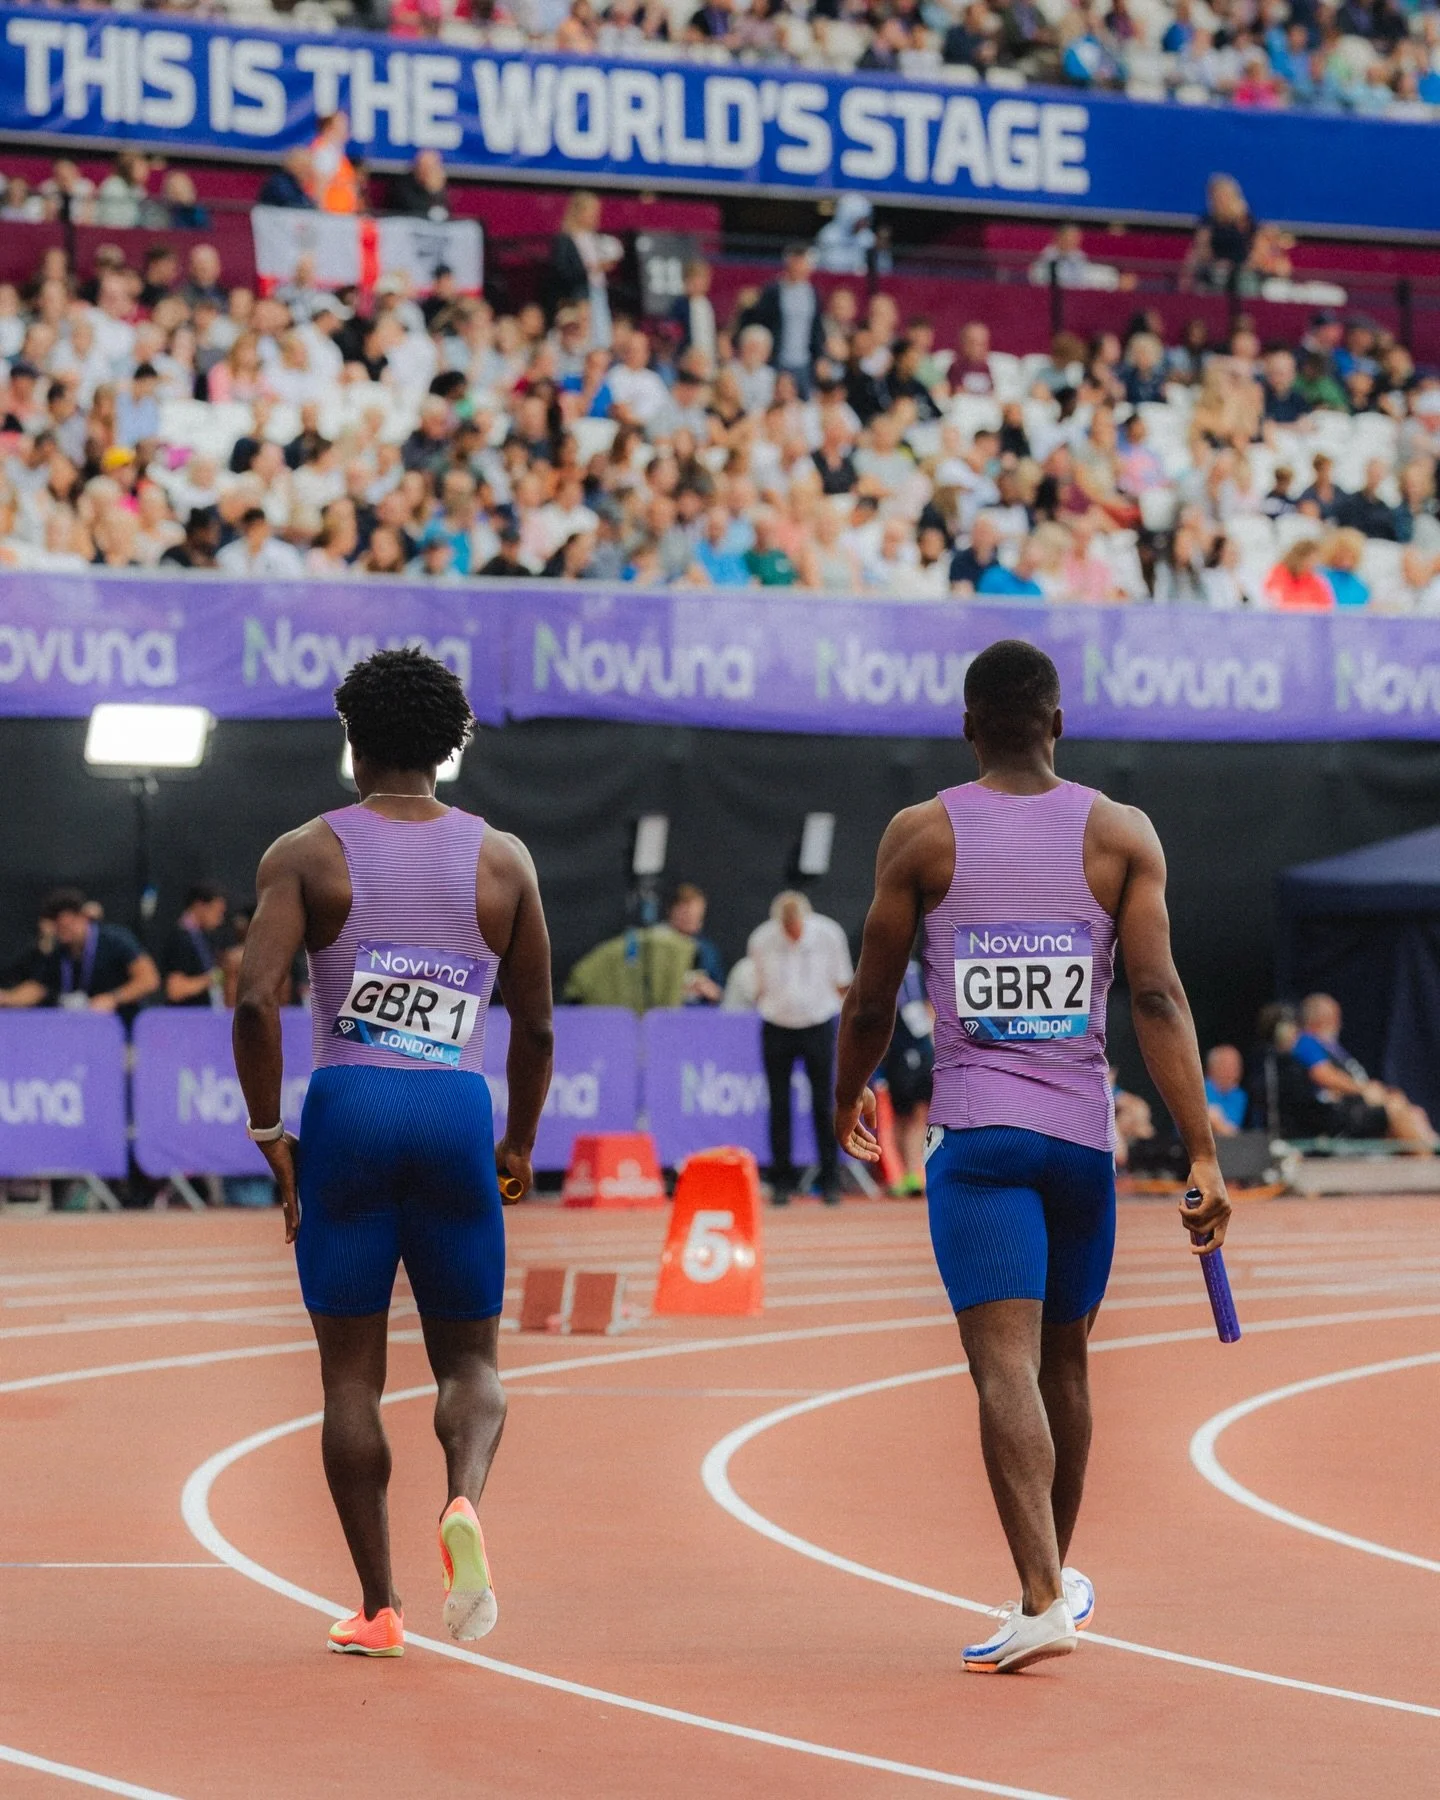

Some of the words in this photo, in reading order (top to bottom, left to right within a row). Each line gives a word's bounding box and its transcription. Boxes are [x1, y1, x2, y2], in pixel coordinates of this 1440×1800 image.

[6, 17, 197, 130] THIS
[208, 36, 287, 138] IS
[296, 46, 464, 151] THE
[472, 59, 832, 176] WORLD'S
[839, 86, 1091, 196] STAGE
[534, 621, 754, 699] Novuna
[1082, 641, 1282, 712] Novuna
[1334, 649, 1440, 715] Nov
[370, 949, 469, 987] Novuna
[970, 931, 1073, 954] Novuna
[350, 980, 439, 1033] GBR
[449, 999, 467, 1040] 1
[963, 965, 1053, 1010] GBR
[1063, 963, 1085, 1009] 2
[379, 1030, 445, 1060] LONDON
[1008, 1019, 1073, 1035] LONDON
[682, 1209, 735, 1284] 5
